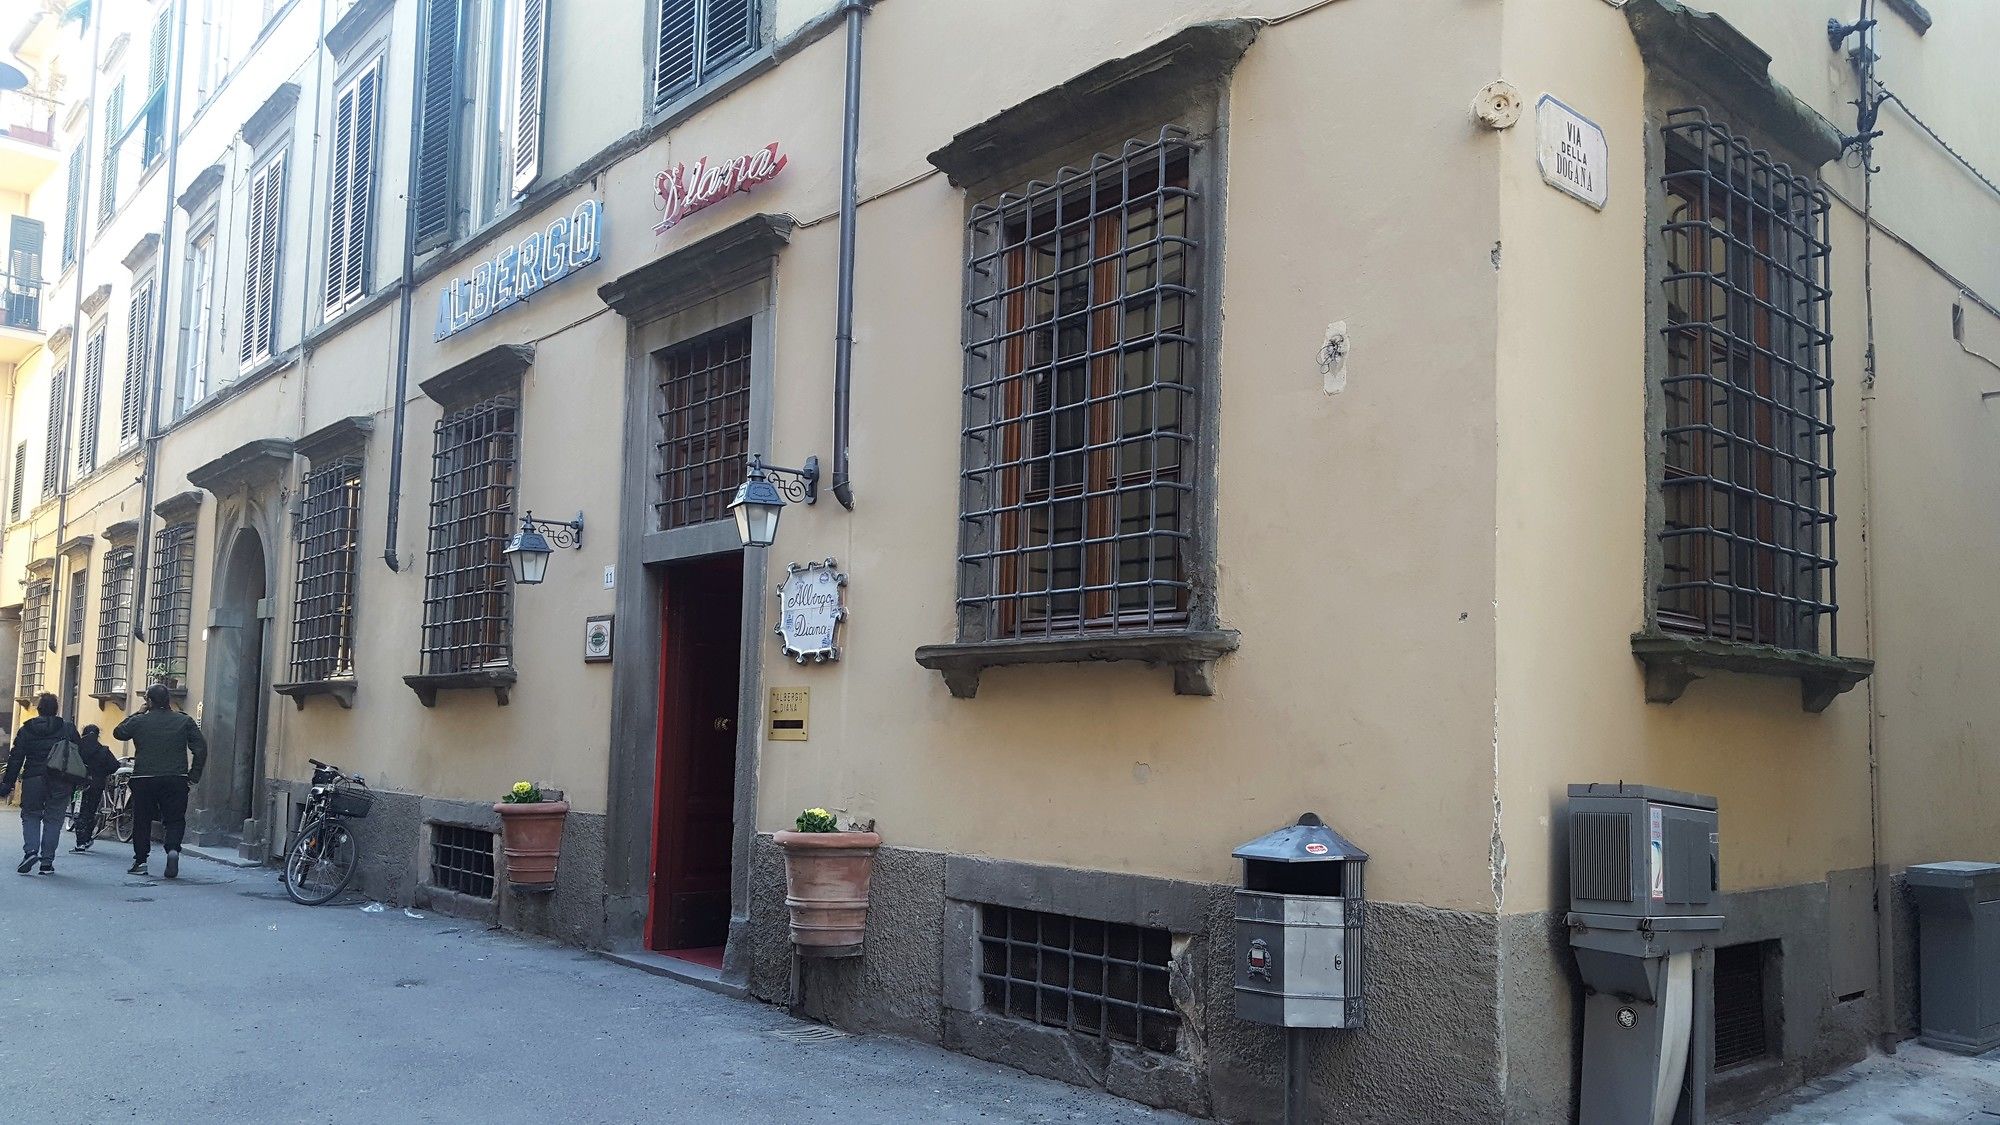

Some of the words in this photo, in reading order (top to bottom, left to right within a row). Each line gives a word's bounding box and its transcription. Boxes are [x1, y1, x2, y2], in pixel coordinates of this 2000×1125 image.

[1567, 121, 1581, 147] VIA
[1562, 141, 1587, 165] DELLA
[651, 141, 787, 236] Diana
[1556, 152, 1593, 192] DOGANA
[434, 199, 601, 342] ALBERGO
[794, 613, 827, 637] Diana
